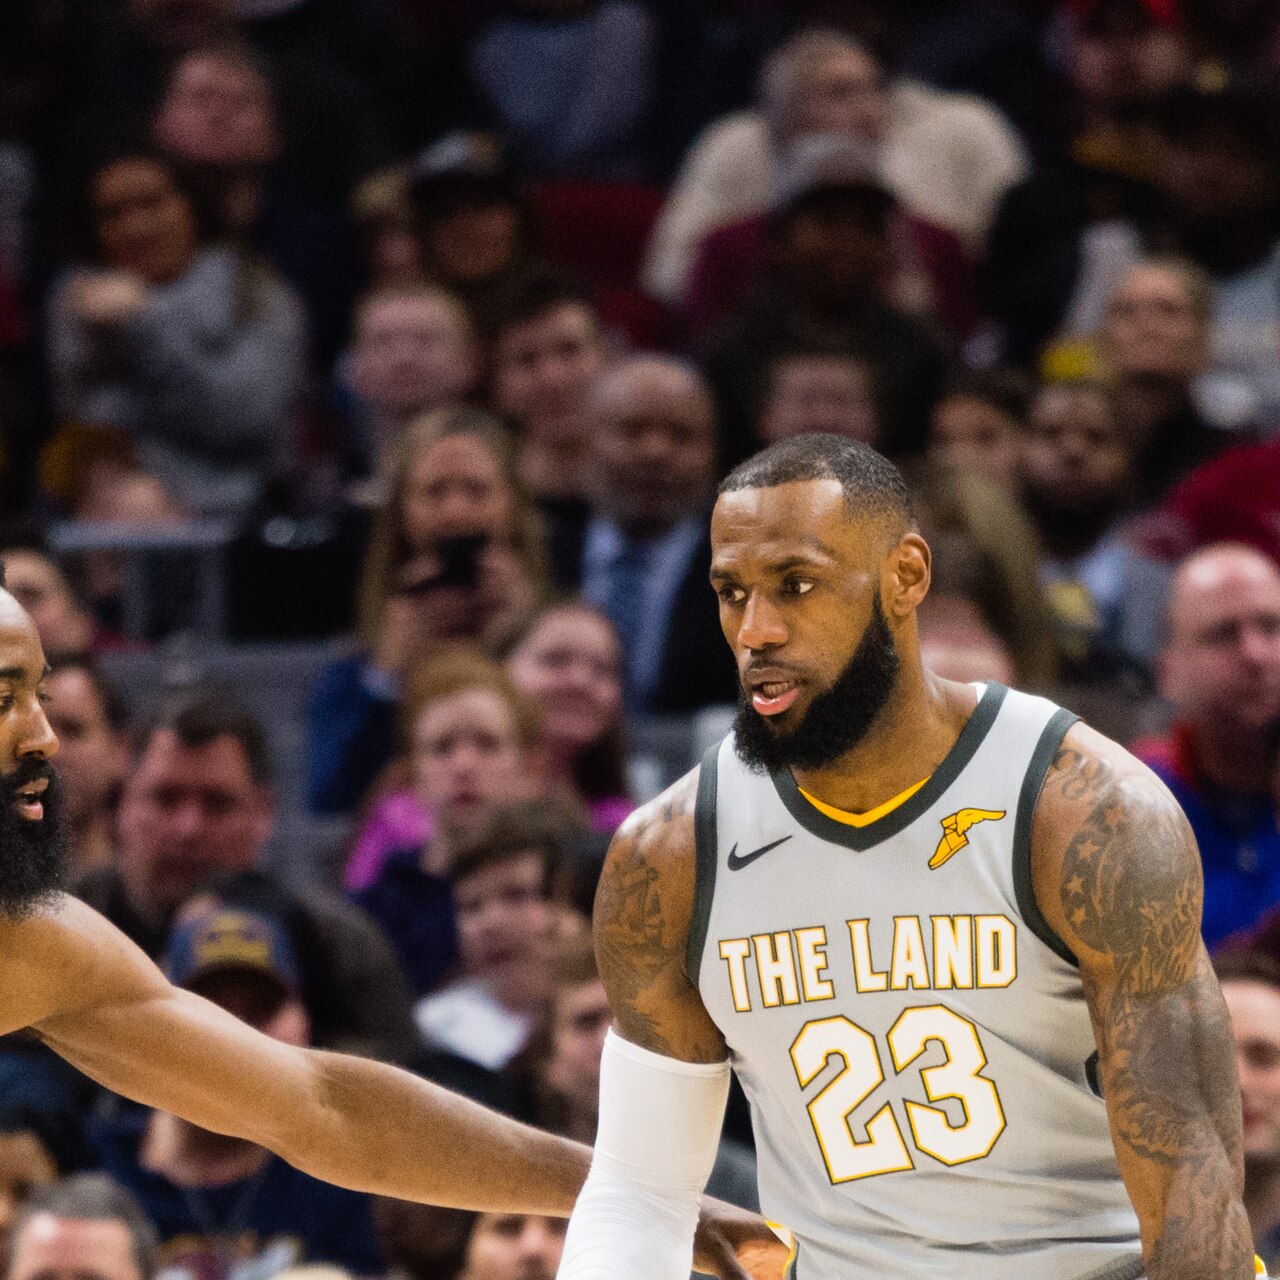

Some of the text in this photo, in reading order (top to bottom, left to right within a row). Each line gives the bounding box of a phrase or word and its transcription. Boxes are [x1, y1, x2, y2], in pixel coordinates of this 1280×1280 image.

[718, 913, 1018, 1013] THE LAND
[788, 1003, 1008, 1186] 23
